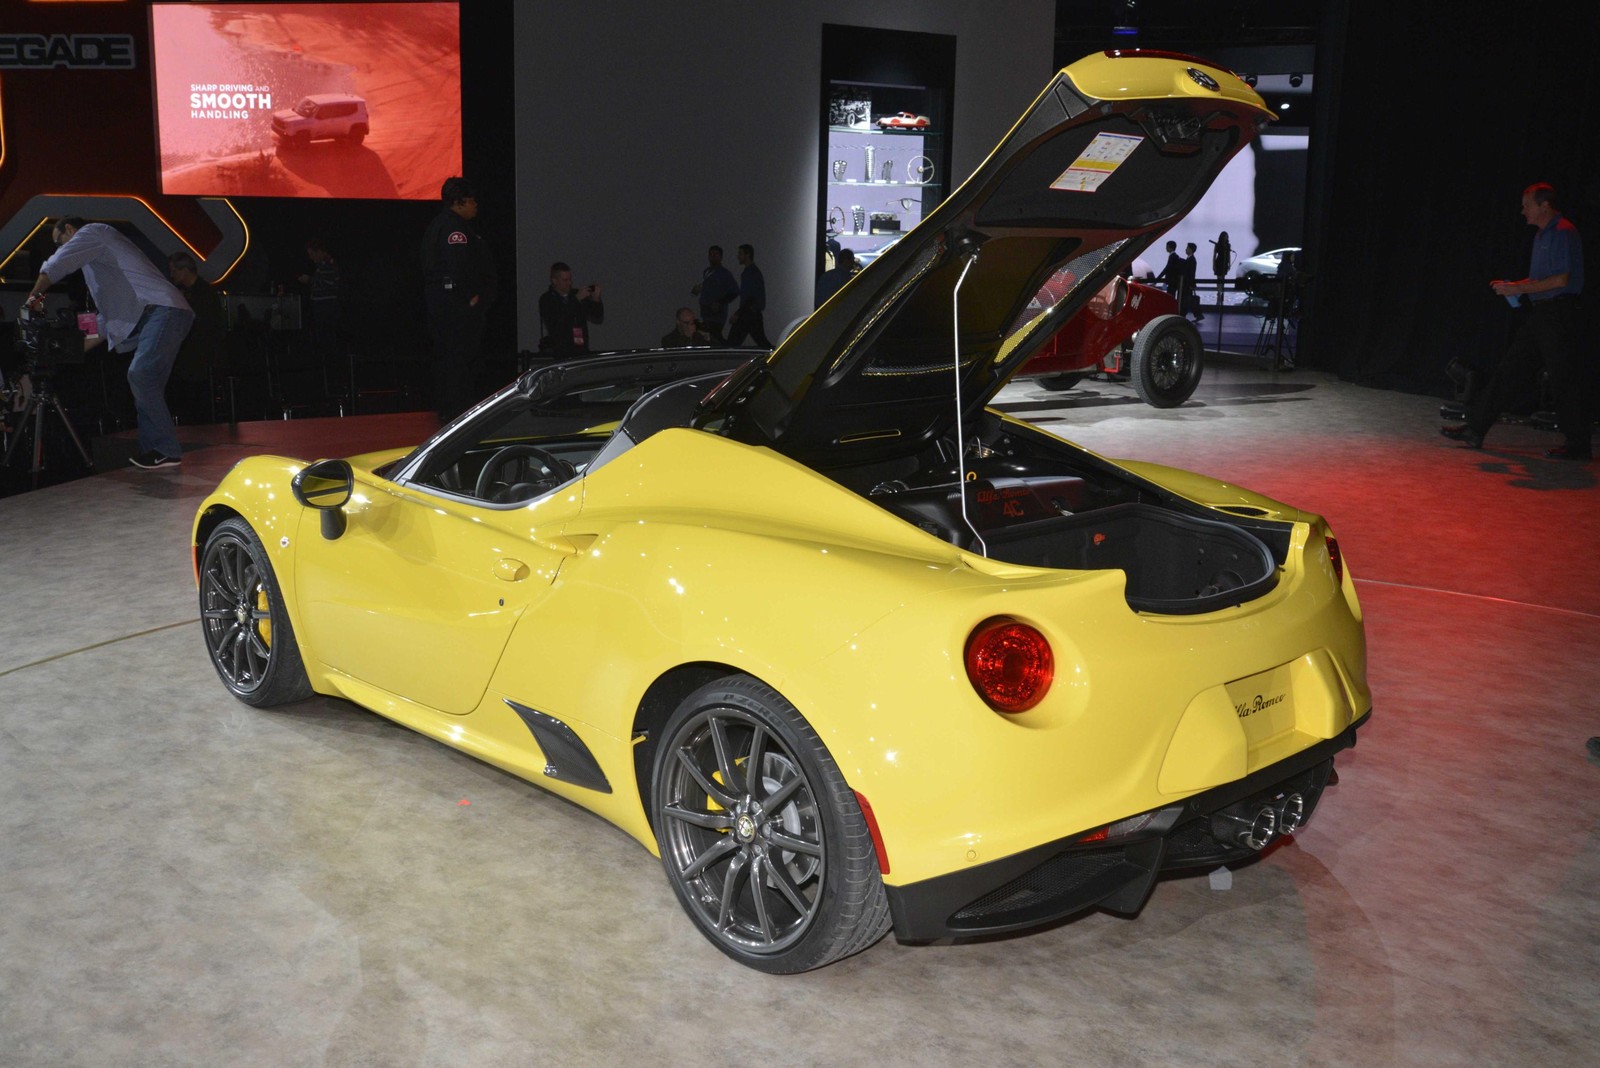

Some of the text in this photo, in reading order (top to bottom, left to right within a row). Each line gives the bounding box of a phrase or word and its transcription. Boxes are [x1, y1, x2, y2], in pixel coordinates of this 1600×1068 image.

[219, 84, 253, 92] DRIVING
[190, 93, 272, 109] SMOOTH
[191, 110, 249, 119] HANDLING
[1003, 500, 1025, 517] 4C
[1252, 694, 1286, 713] Romeo
